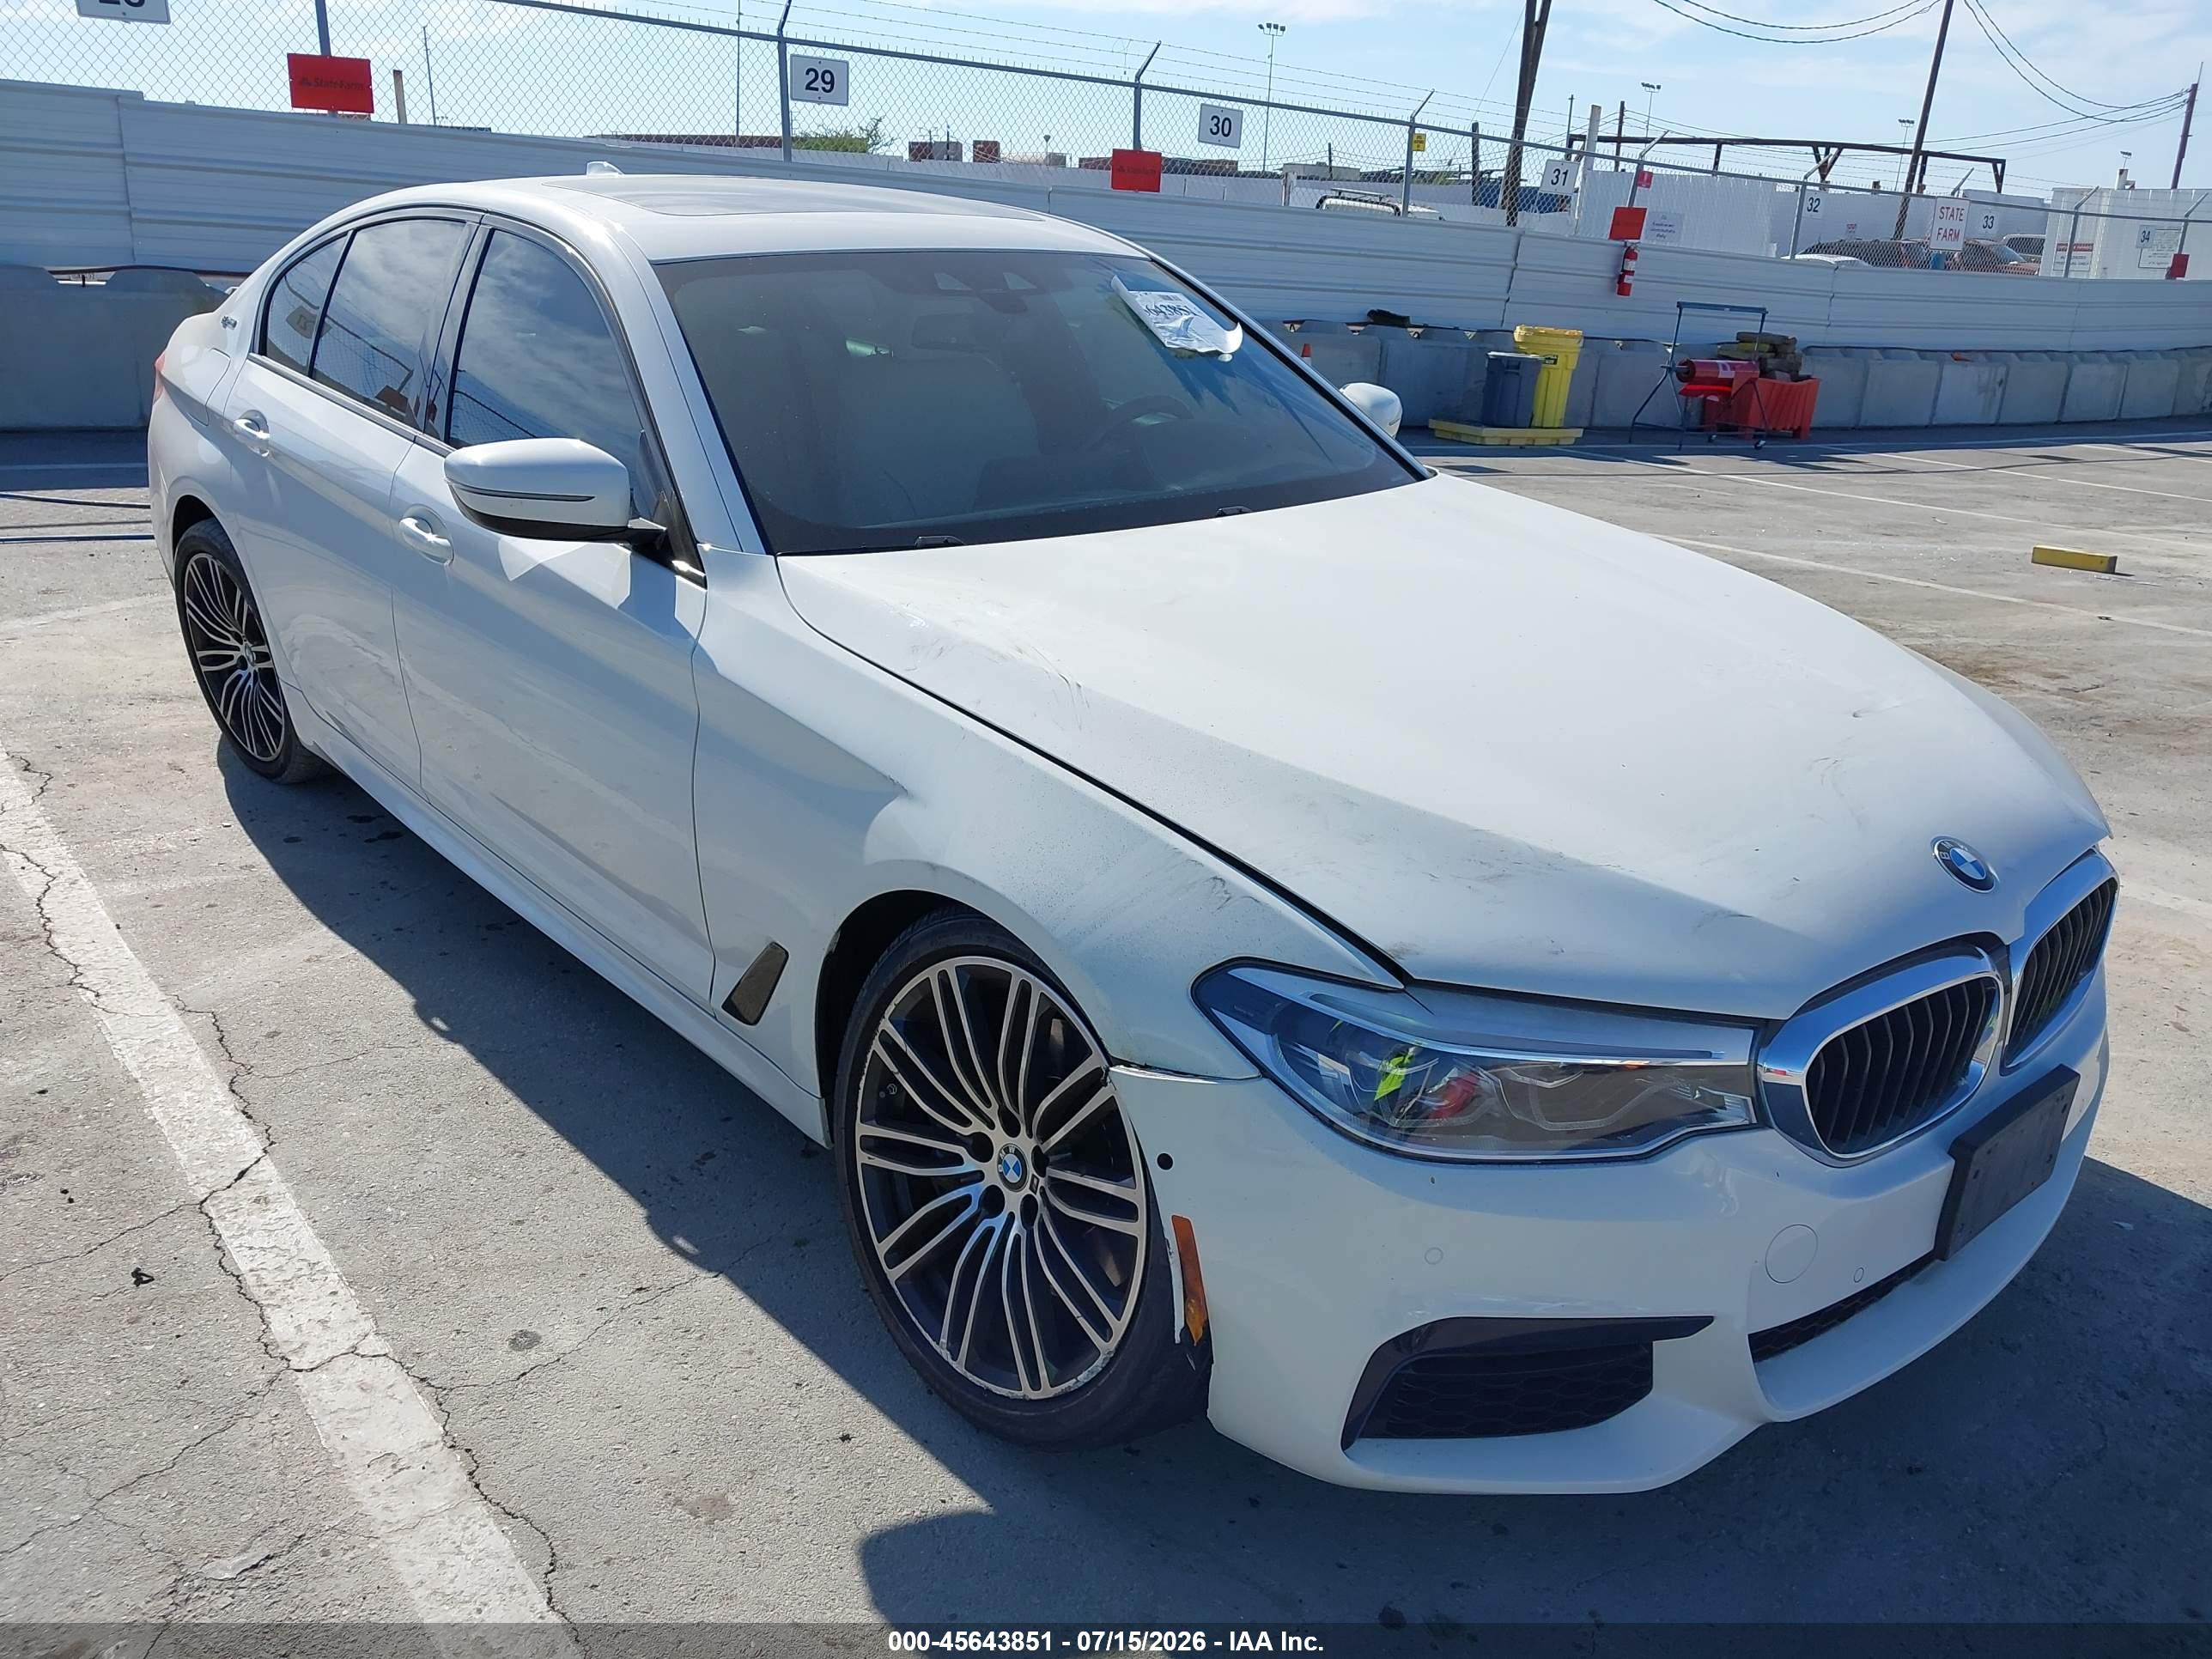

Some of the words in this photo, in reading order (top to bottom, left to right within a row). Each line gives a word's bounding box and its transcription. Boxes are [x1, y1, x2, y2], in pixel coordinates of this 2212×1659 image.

[805, 68, 835, 93] 29
[1209, 115, 1231, 137] 30
[1551, 168, 1569, 185] 31
[1807, 197, 1820, 212] 32
[1939, 206, 1965, 222] STATE
[1983, 216, 1994, 229] 33
[1936, 228, 1960, 241] FARM
[2141, 230, 2150, 243] 34
